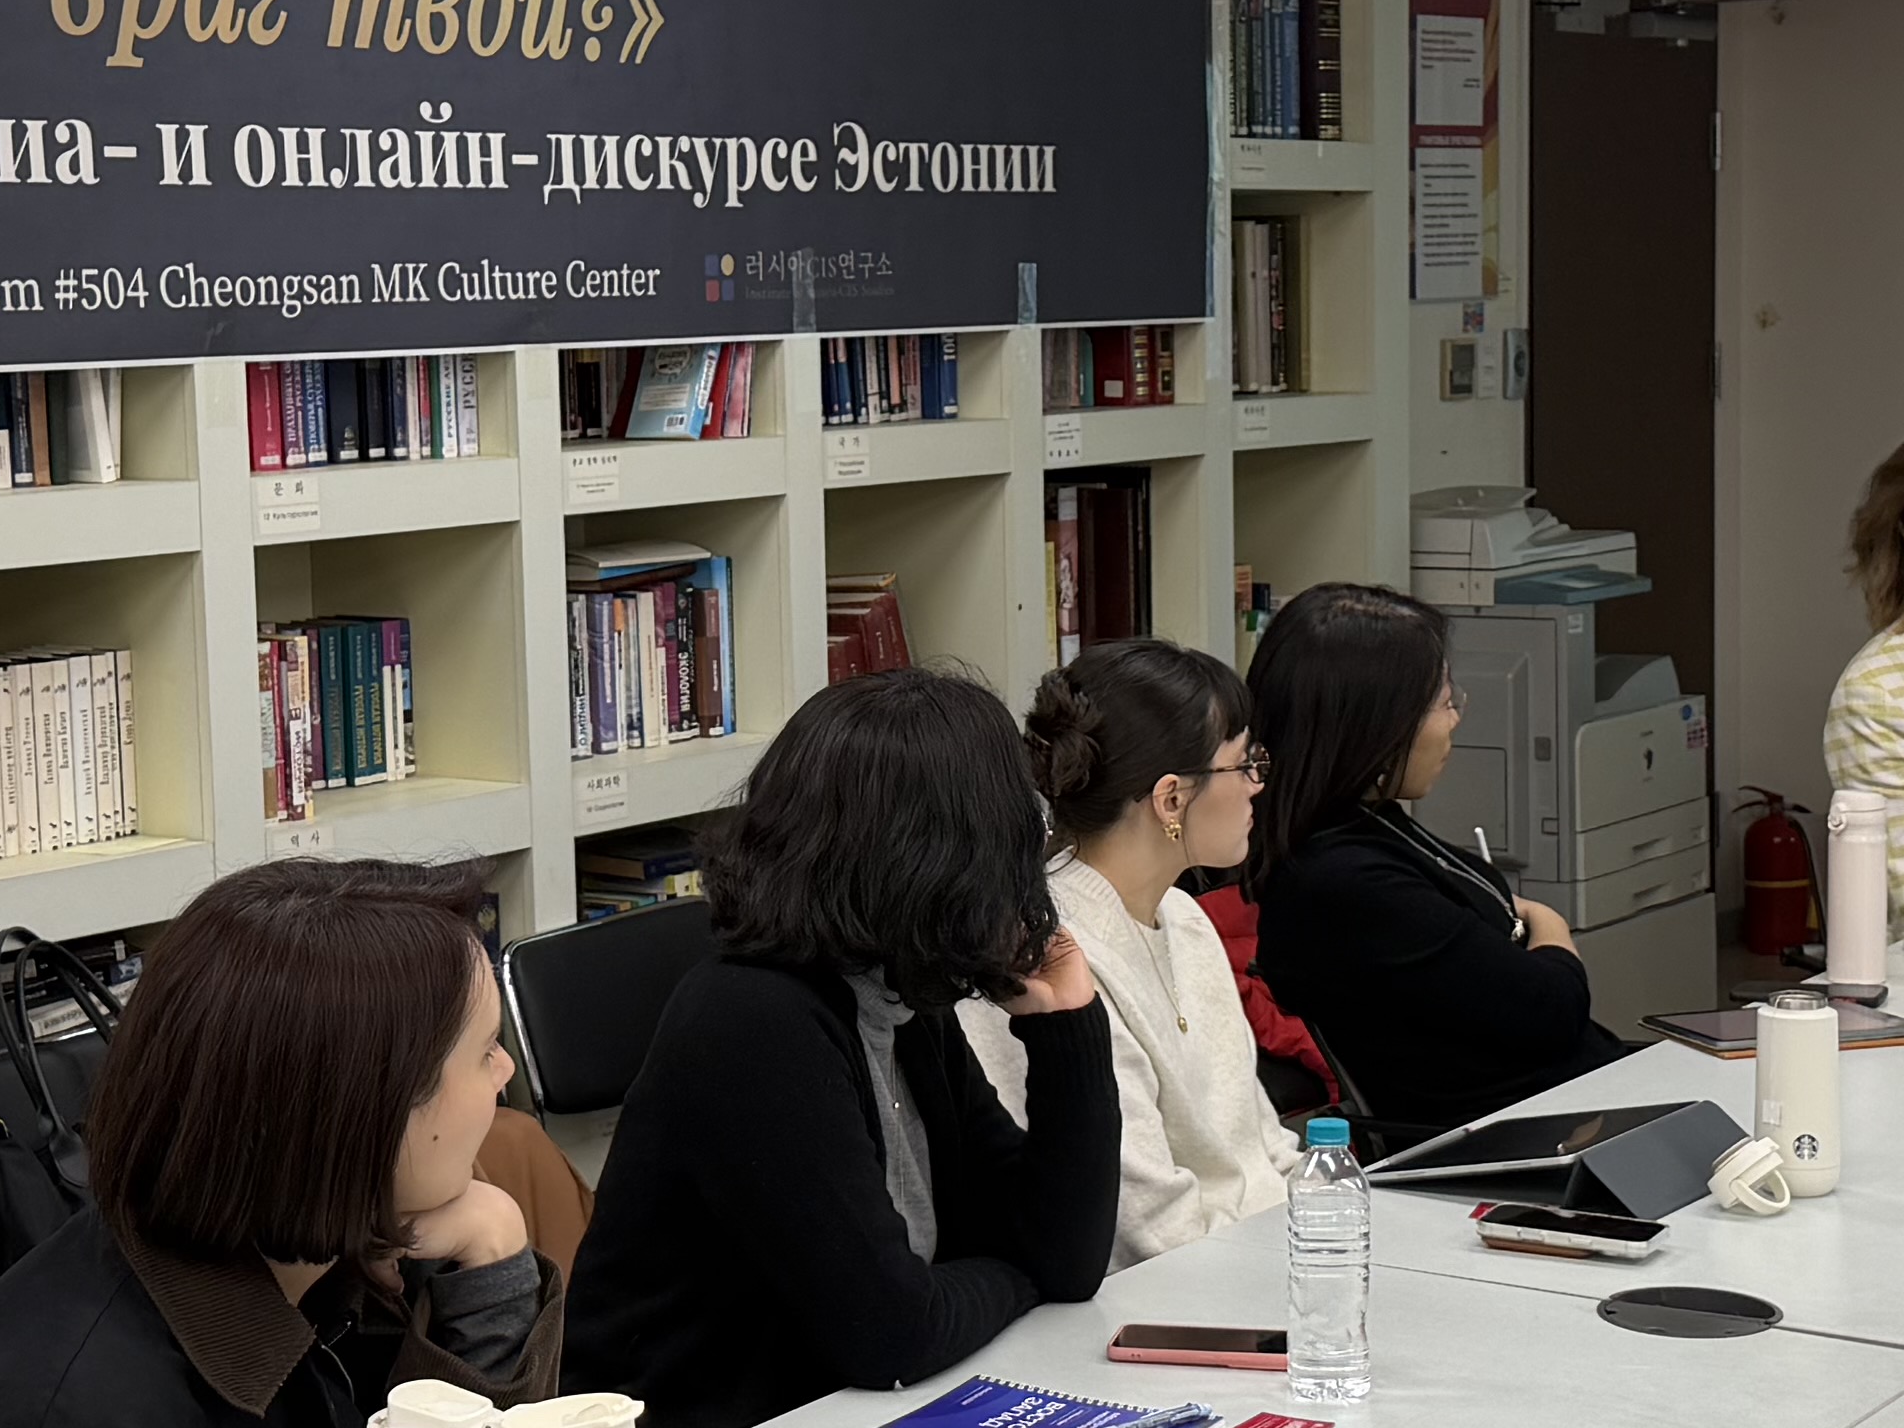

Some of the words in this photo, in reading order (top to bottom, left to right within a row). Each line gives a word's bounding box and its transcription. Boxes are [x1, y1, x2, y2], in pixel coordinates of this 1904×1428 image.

[162, 120, 210, 189] и
[235, 103, 818, 210] онлайн-дискурсе
[831, 121, 1057, 196] Эстонии
[54, 266, 149, 313] #504
[159, 262, 362, 322] Cheongsan
[370, 261, 429, 306] MK
[437, 258, 558, 305] Culture
[565, 258, 660, 300] Center
